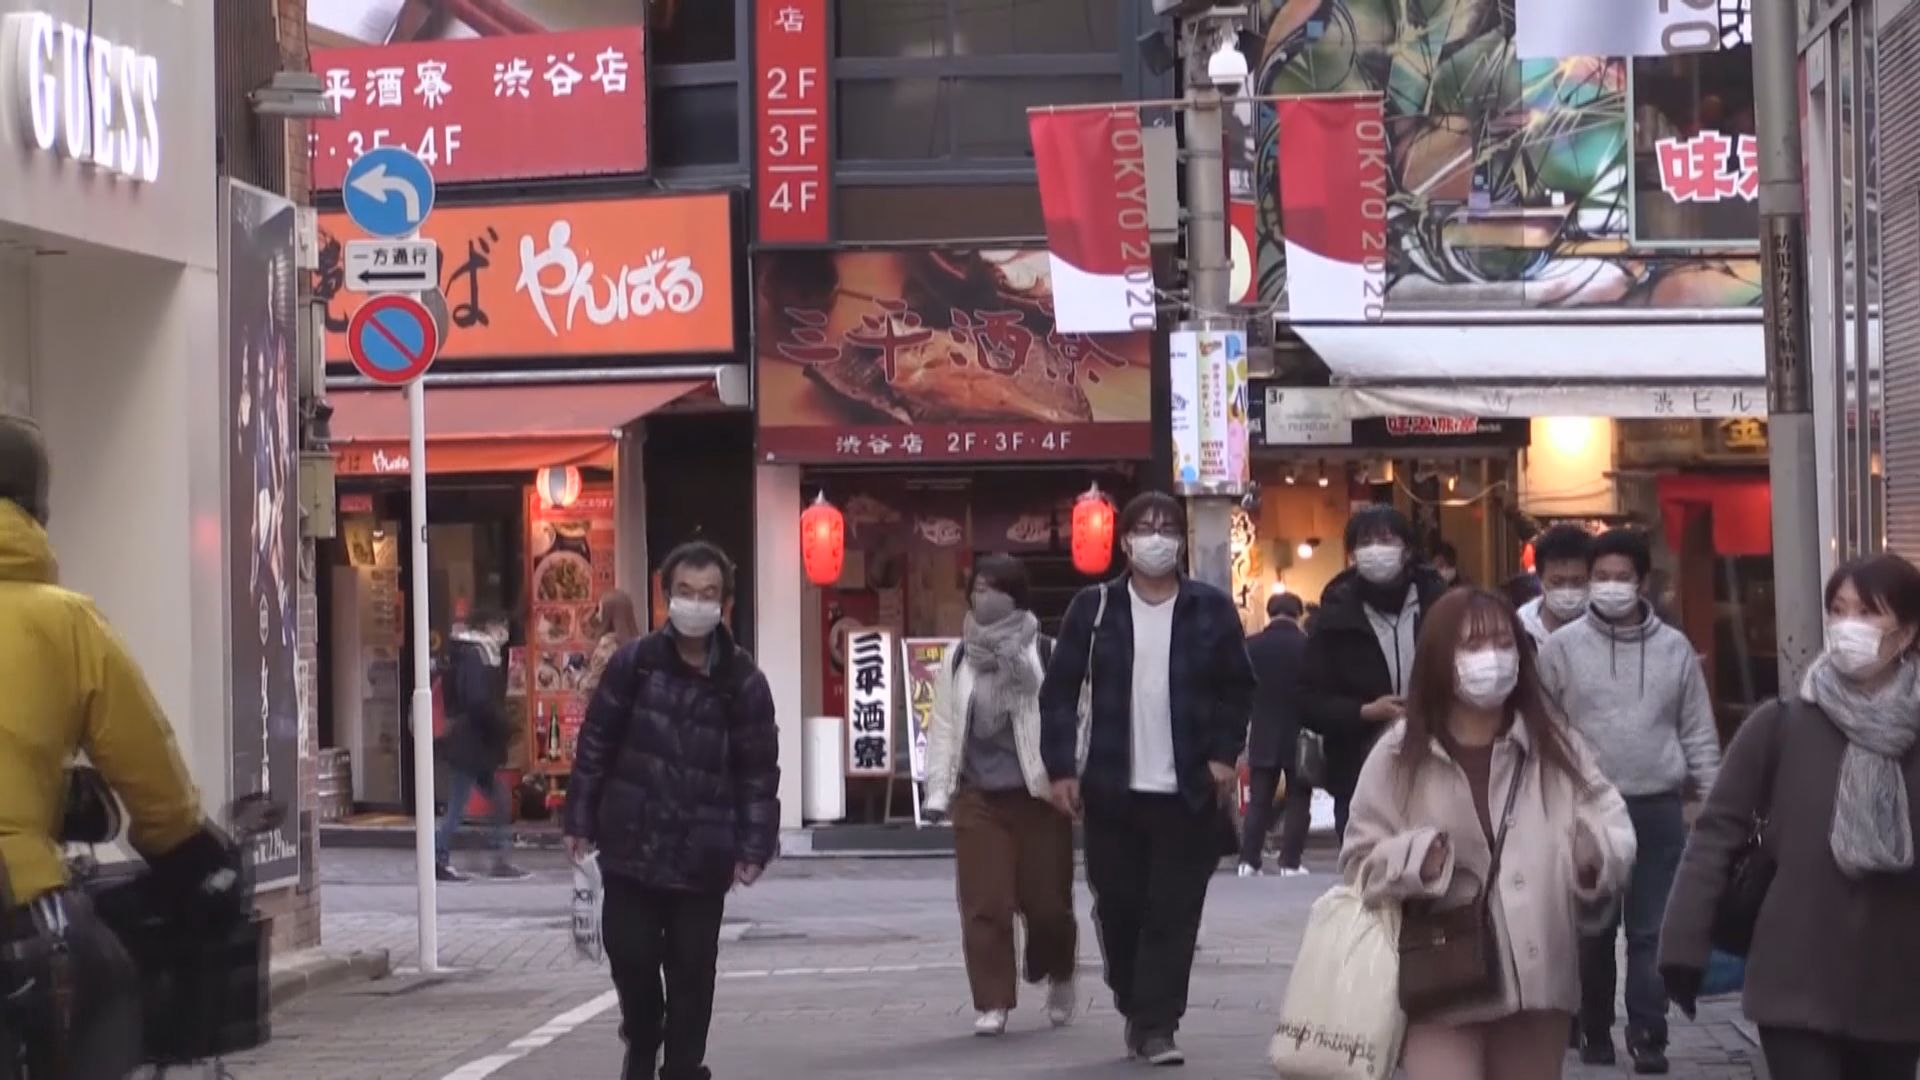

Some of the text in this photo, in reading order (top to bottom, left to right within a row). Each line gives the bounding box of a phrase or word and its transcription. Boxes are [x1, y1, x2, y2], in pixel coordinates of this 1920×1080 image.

[775, 6, 804, 32] 店
[493, 46, 628, 99] 渋谷店
[767, 67, 816, 99] 2F
[28, 11, 160, 183] GUESS
[768, 124, 817, 157] 3F
[769, 181, 819, 213] 4F
[1110, 106, 1157, 331] TOKYO 2020
[1354, 99, 1387, 323] TOKYO 2020
[352, 246, 428, 266] 一方通行
[515, 219, 703, 337] やんばる
[836, 433, 924, 454] 渋谷店
[853, 632, 887, 769] 三平酒寮
